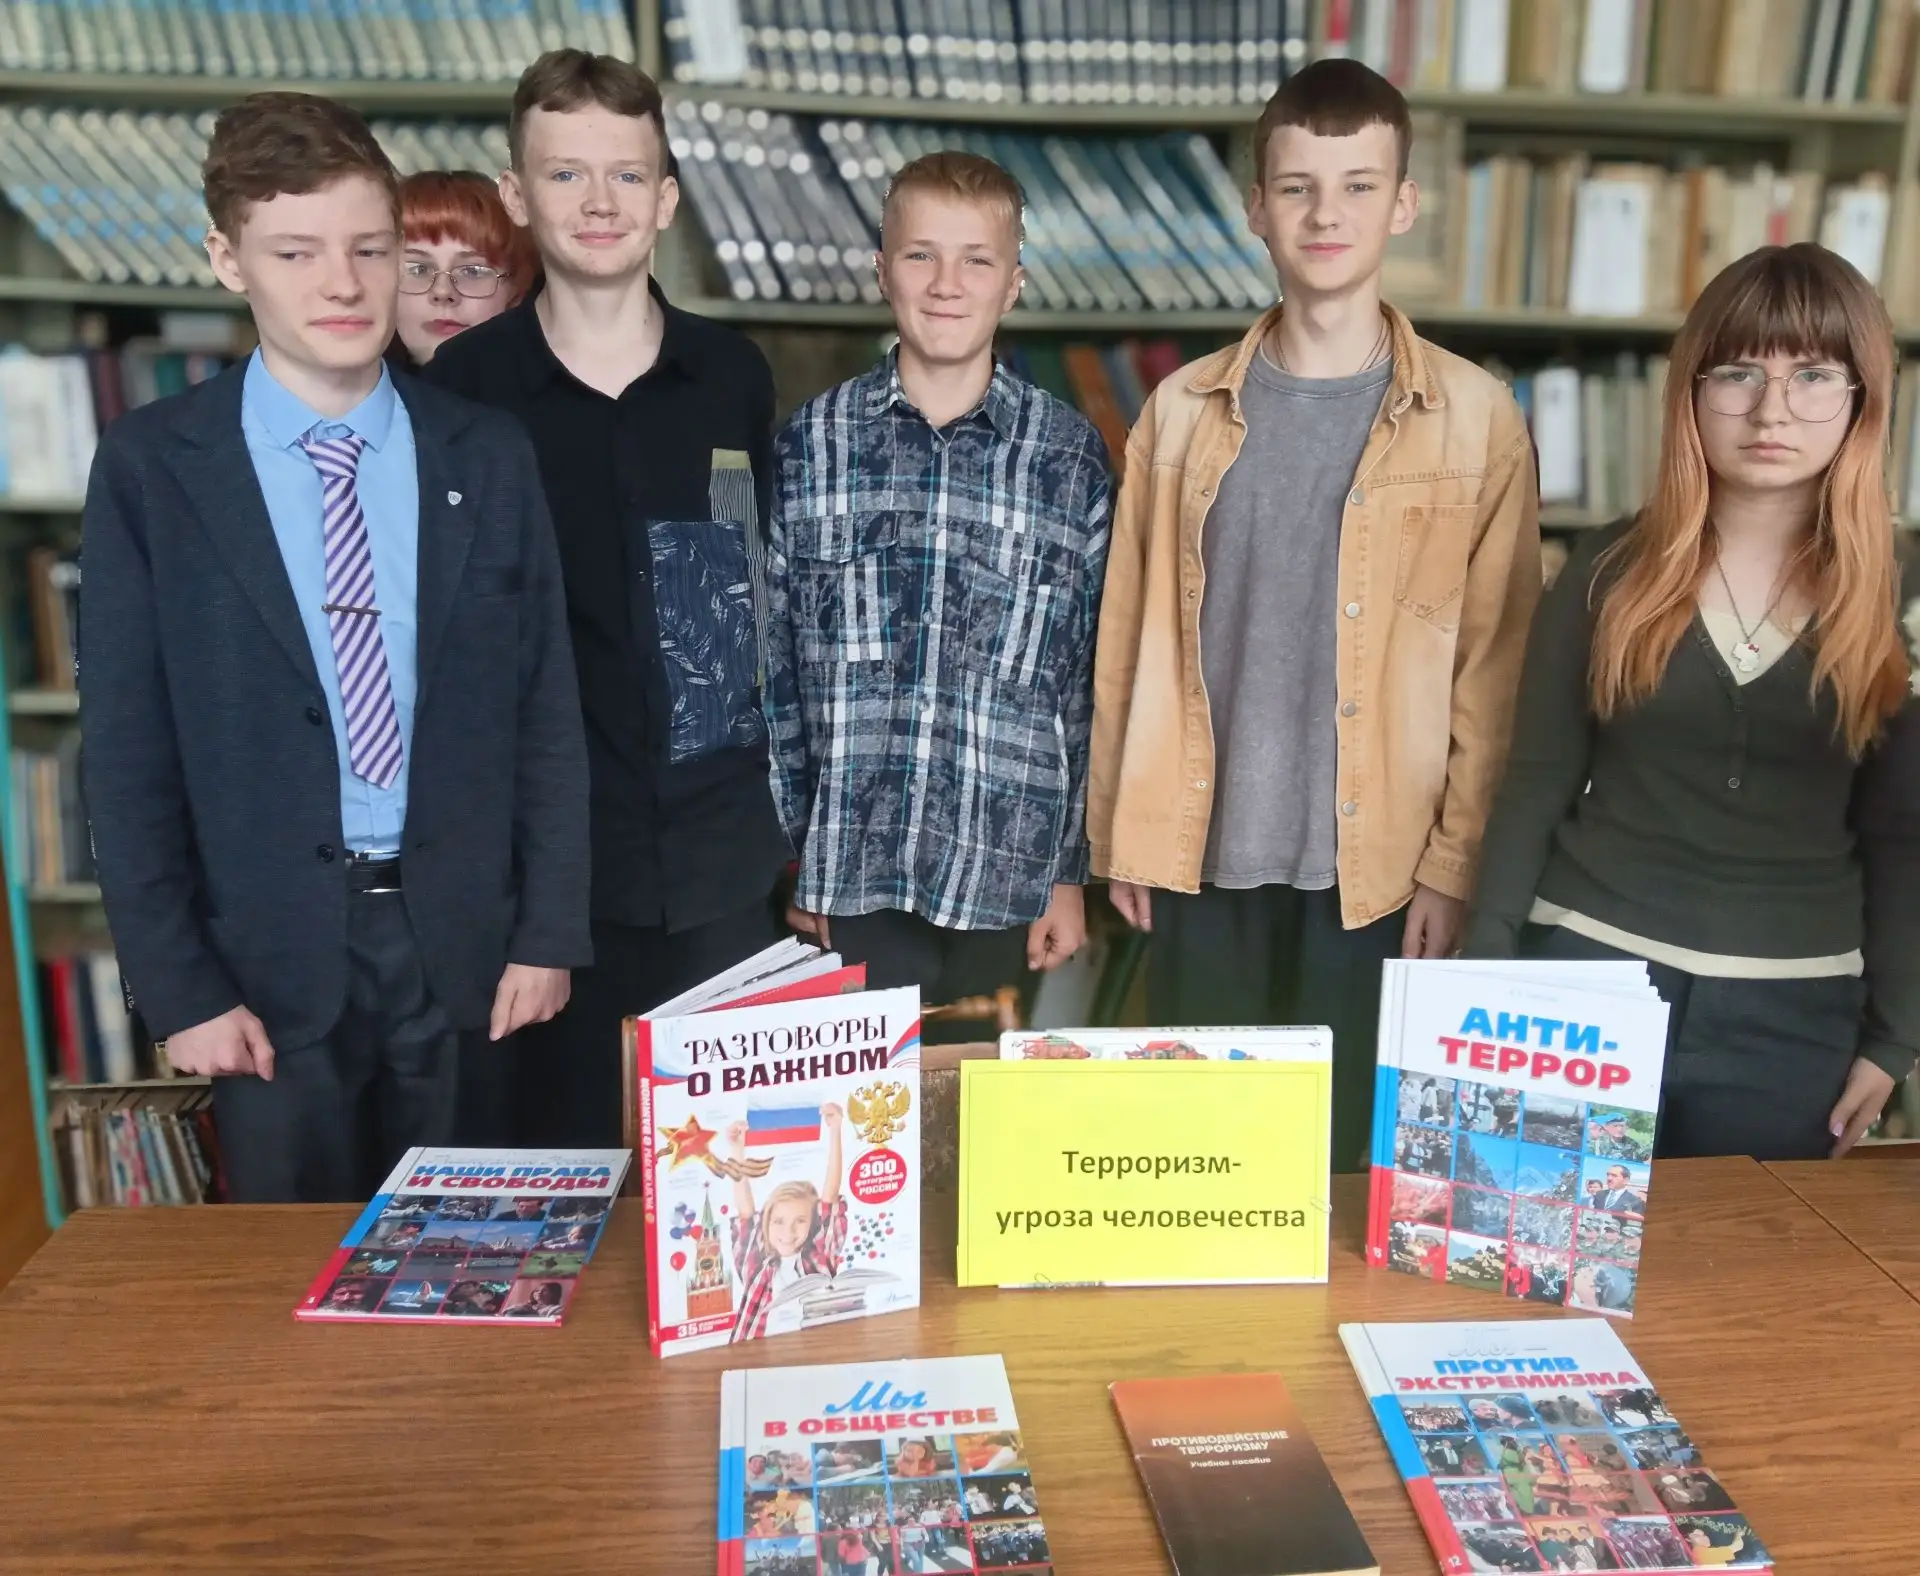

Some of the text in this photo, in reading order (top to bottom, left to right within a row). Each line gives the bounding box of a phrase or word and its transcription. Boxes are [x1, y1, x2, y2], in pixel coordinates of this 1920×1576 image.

[684, 1014, 888, 1065] РАЗГОВОРЫ
[1458, 1006, 1618, 1055] АНТИ-
[687, 1046, 888, 1097] О ВАЖНОМ
[1438, 1035, 1631, 1091] ТЕРРОР
[414, 1165, 611, 1177] НАШИ ПРАВА
[859, 1158, 897, 1178] 300
[1062, 1150, 1242, 1178] Терроризм-
[406, 1175, 610, 1190] И СВОБОДЫ
[996, 1208, 1306, 1234] угроза человечества
[677, 1323, 698, 1338] 35
[1434, 1356, 1579, 1375] ПРОТИВ
[1395, 1371, 1640, 1392] ЭКСТРЕМИЗМА
[824, 1379, 928, 1415] Мы
[764, 1407, 998, 1437] В ОБЩЕСТВЕ
[1152, 1429, 1289, 1447] ПРОТИВОДЕЙСТВИЕ
[1178, 1442, 1269, 1455] ТЕРРОРИЗМУ
